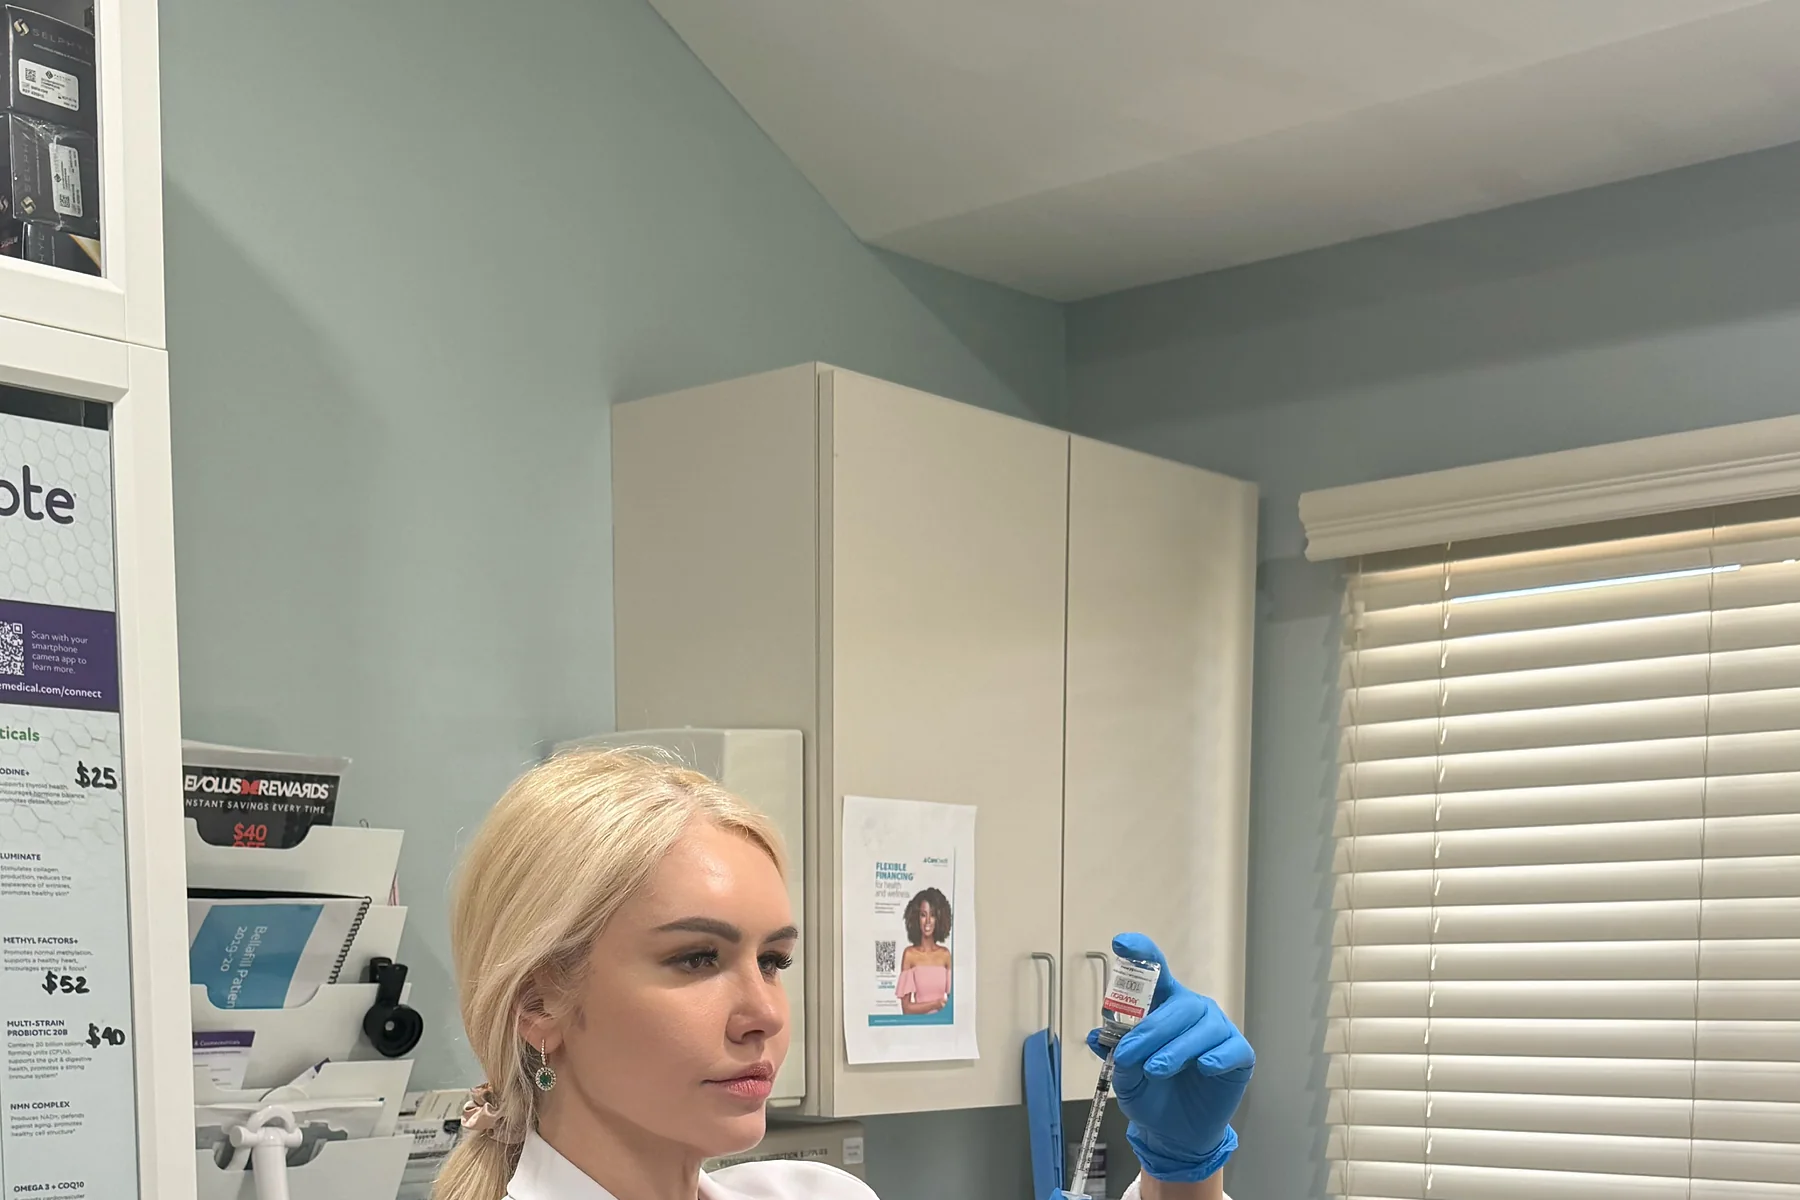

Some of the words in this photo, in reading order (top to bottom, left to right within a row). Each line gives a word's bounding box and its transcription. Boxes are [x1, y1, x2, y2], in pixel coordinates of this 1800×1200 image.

[31, 630, 50, 641] Scan
[51, 633, 70, 642] with
[70, 637, 88, 645] your
[31, 642, 78, 654] smartphone
[32, 653, 60, 662] camera
[61, 656, 77, 666] app
[32, 662, 52, 672] learn
[53, 666, 76, 675] more.
[75, 760, 118, 790] $25
[184, 774, 242, 794] EVOLUS
[258, 779, 329, 799] REWARDS
[227, 800, 269, 812] SAVINGS
[272, 802, 302, 813] EVERY
[304, 804, 327, 815] TIME
[233, 822, 268, 842] $40
[876, 861, 907, 872] FLEXIBLE
[876, 871, 914, 882] FINANCING
[3, 936, 37, 944] METHYL
[239, 925, 268, 968] Bellafill
[220, 925, 248, 973] 2019-20
[41, 970, 91, 996] $52
[7, 1019, 66, 1028] MULTI-STRAIN
[7, 1028, 52, 1037] PROBIOTIC
[10, 1102, 31, 1110] NMN
[31, 1100, 71, 1110] COMPLEX
[13, 1184, 44, 1192] OMEGA
[44, 1183, 51, 1191] 3
[57, 1181, 85, 1190] COQ10
